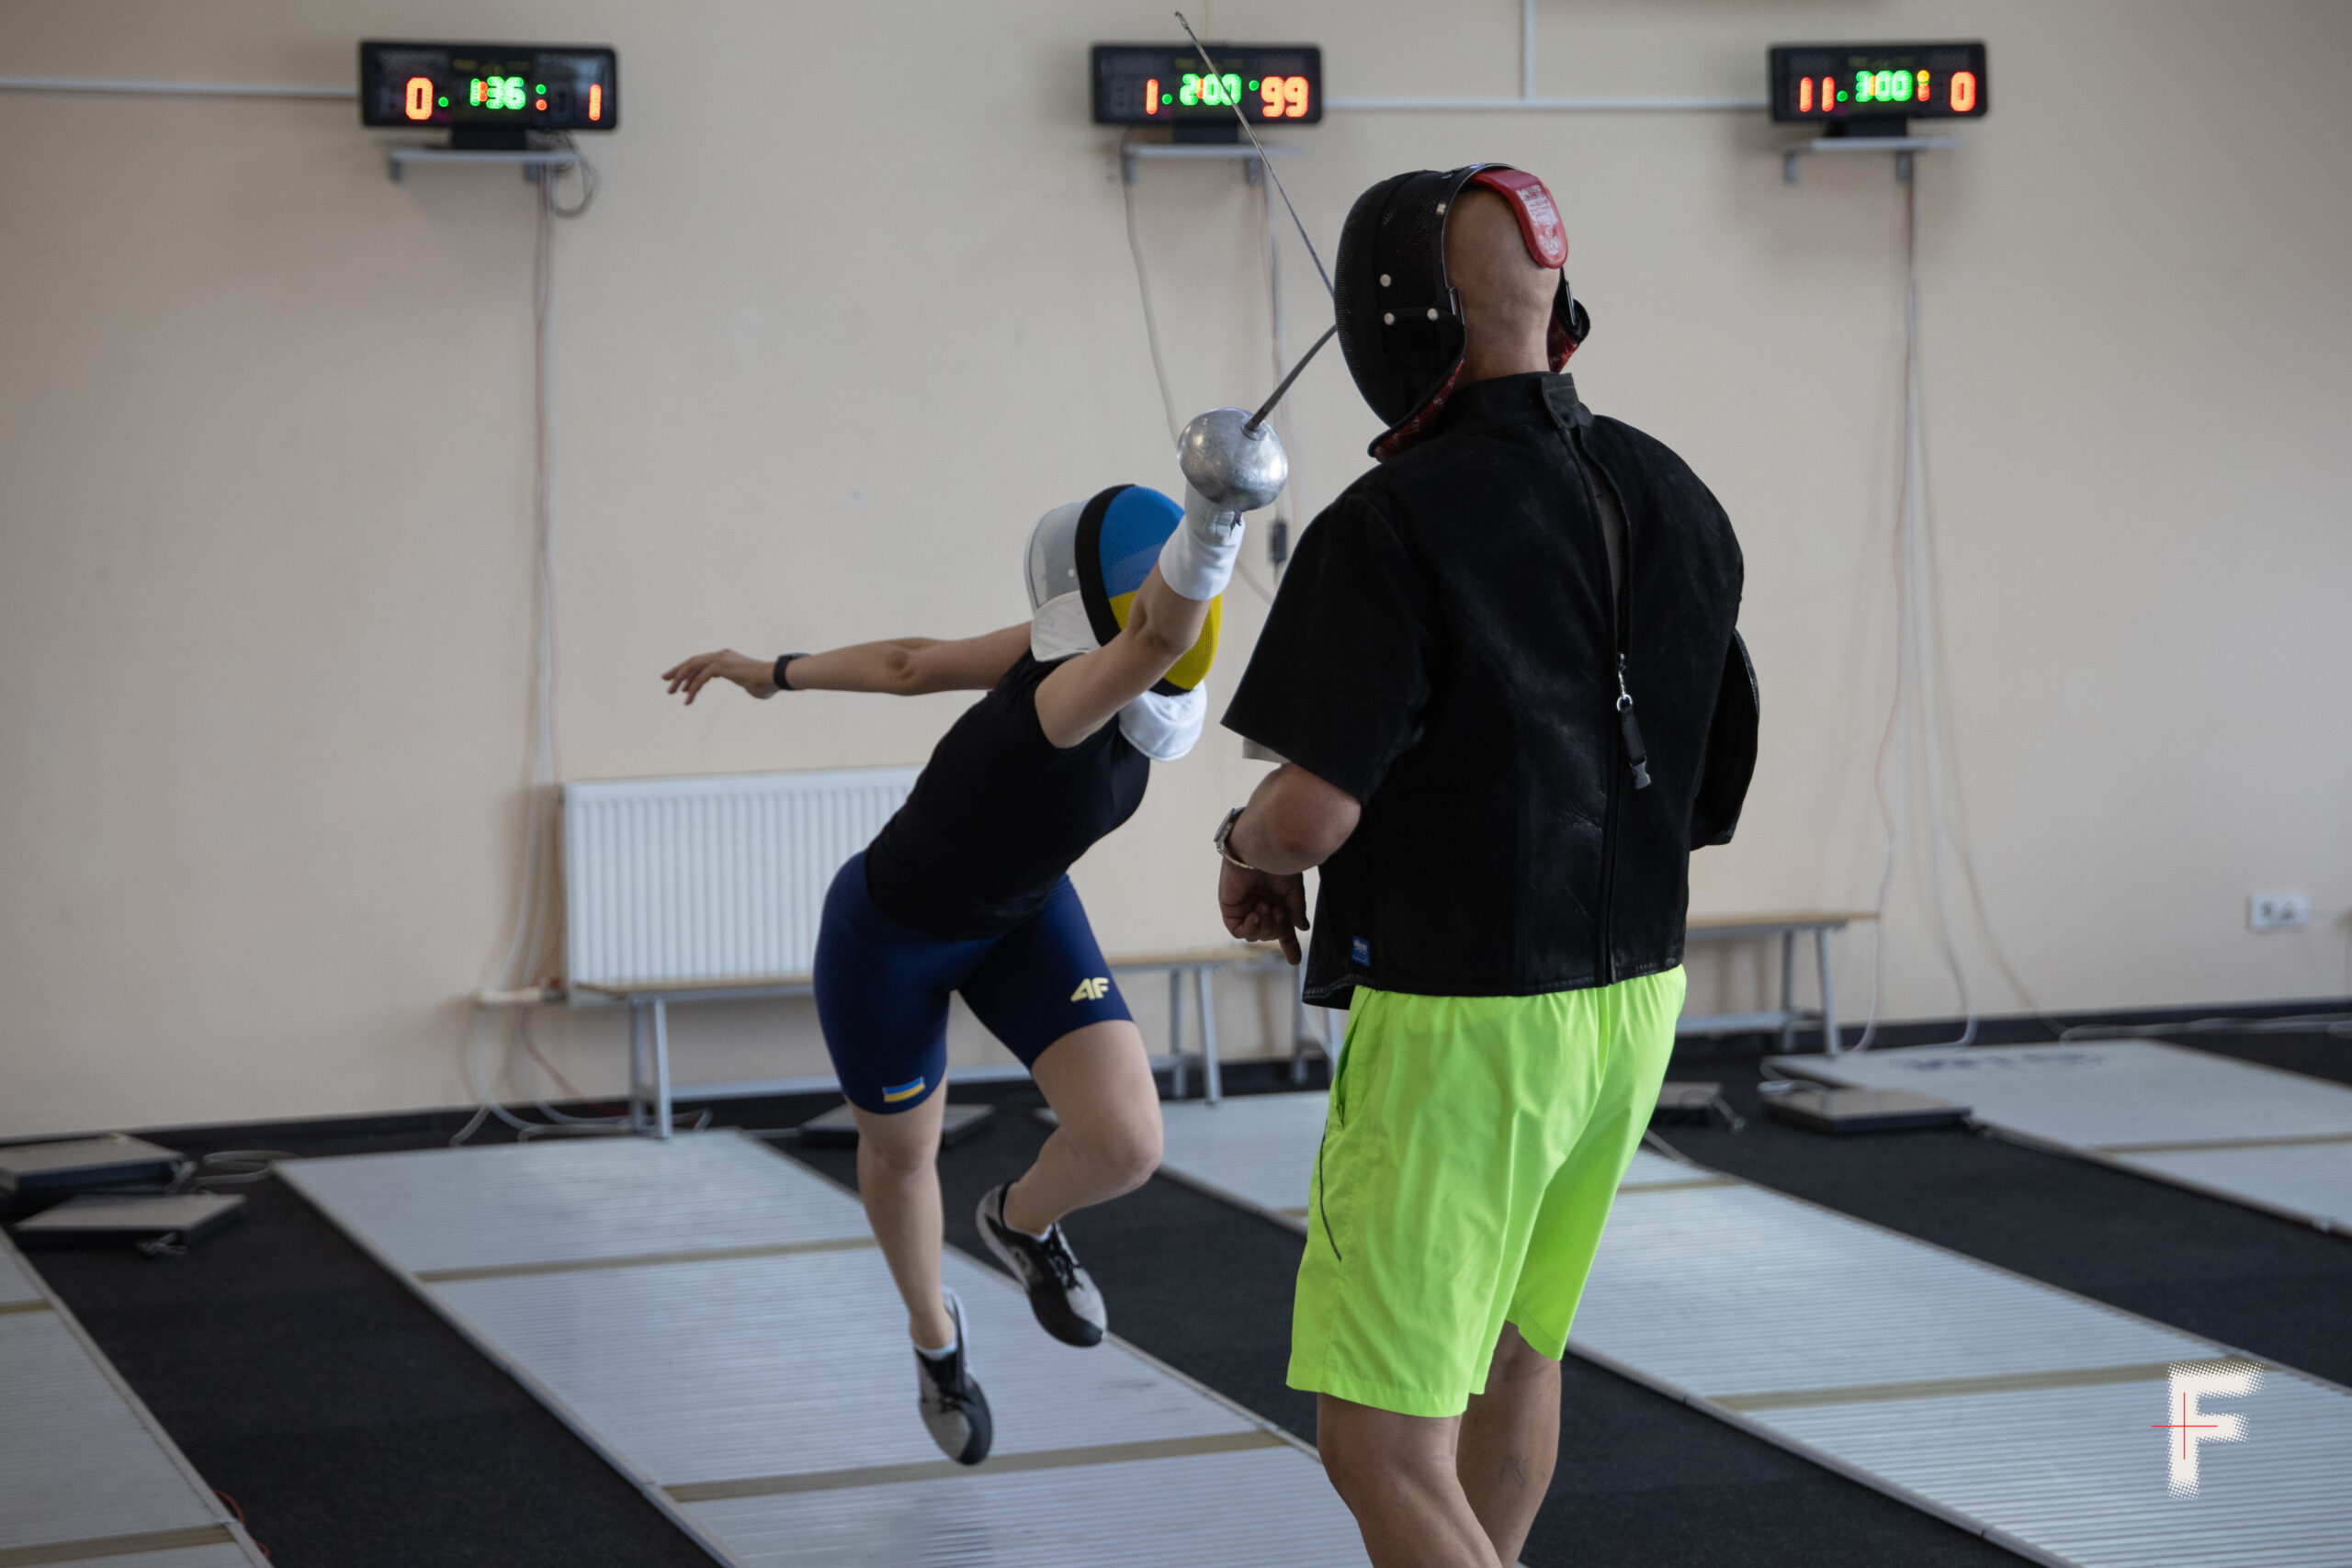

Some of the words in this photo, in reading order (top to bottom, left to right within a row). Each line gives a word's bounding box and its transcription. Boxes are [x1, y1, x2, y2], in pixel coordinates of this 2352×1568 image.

[405, 77, 434, 120] 0
[589, 84, 602, 121] 1
[1146, 78, 1159, 115] 1
[1261, 75, 1309, 118] 99
[1799, 76, 1836, 112] 11
[1950, 71, 1976, 112] 0
